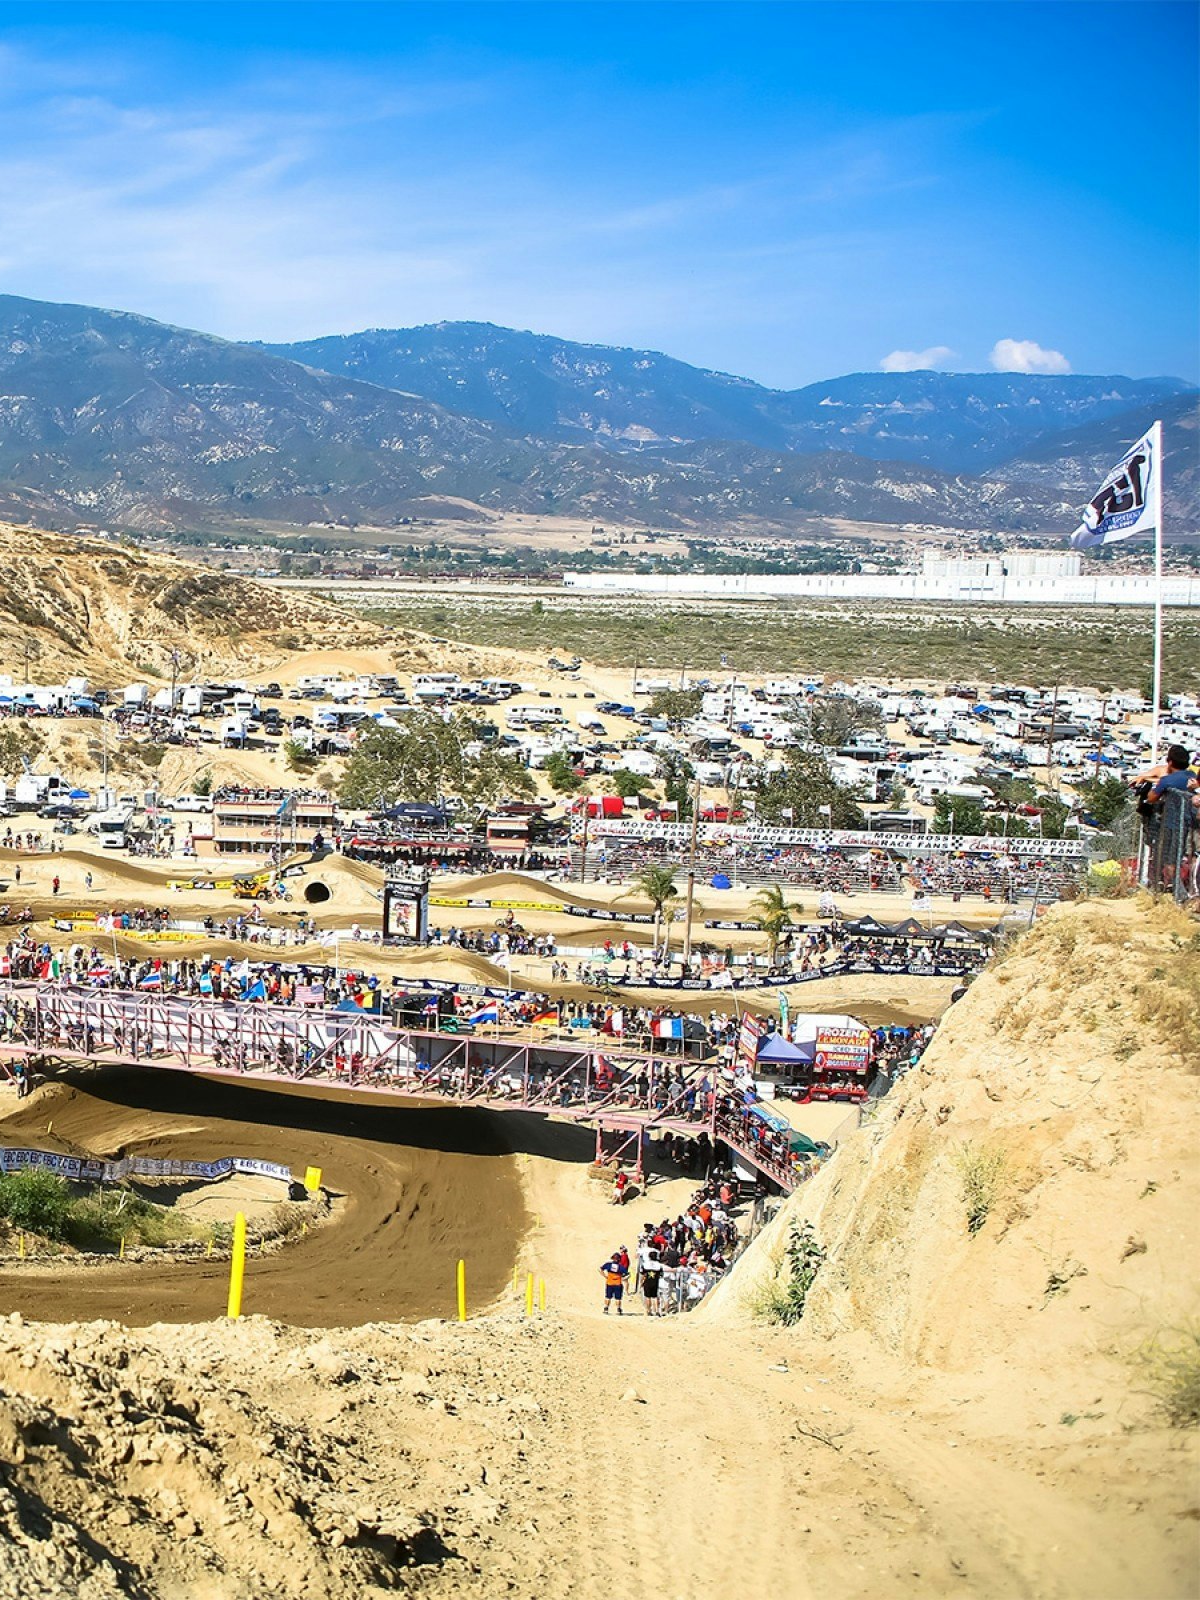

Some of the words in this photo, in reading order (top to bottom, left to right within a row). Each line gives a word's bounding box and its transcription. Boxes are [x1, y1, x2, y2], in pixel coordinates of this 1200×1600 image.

[621, 821, 692, 829] MOTOCROSS
[747, 827, 819, 835] MOTOCROSS
[874, 832, 949, 840] MOTOCROSS
[819, 1028, 860, 1037] FROZEN
